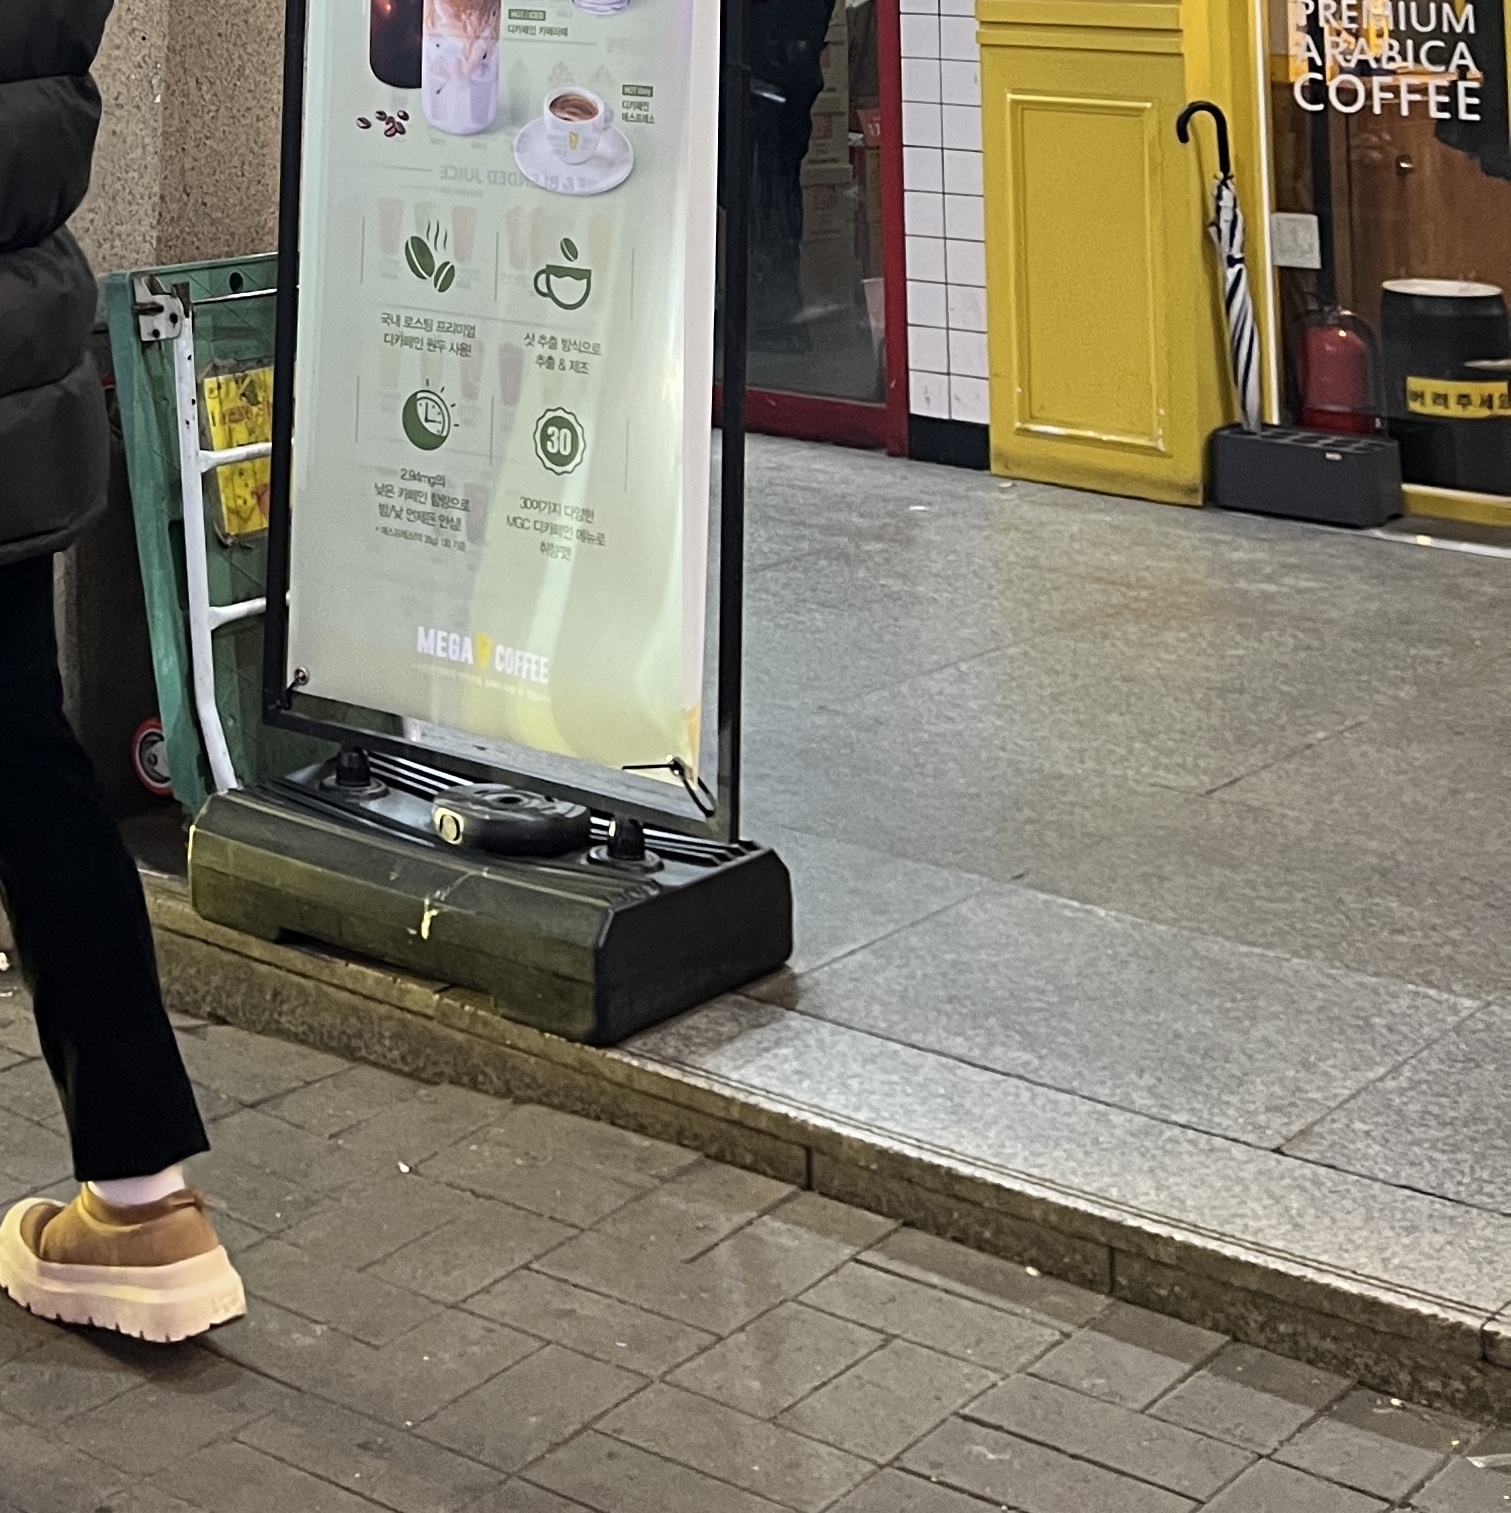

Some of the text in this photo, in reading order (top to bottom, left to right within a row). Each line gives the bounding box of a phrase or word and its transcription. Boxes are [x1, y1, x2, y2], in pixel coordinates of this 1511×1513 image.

[1296, 39, 1478, 74] ARABICA
[1293, 74, 1482, 121] COFFEE
[436, 320, 476, 338] 프리미엄
[546, 428, 572, 456] 30
[417, 626, 474, 665] MEGA
[494, 644, 550, 685] COFFEE
